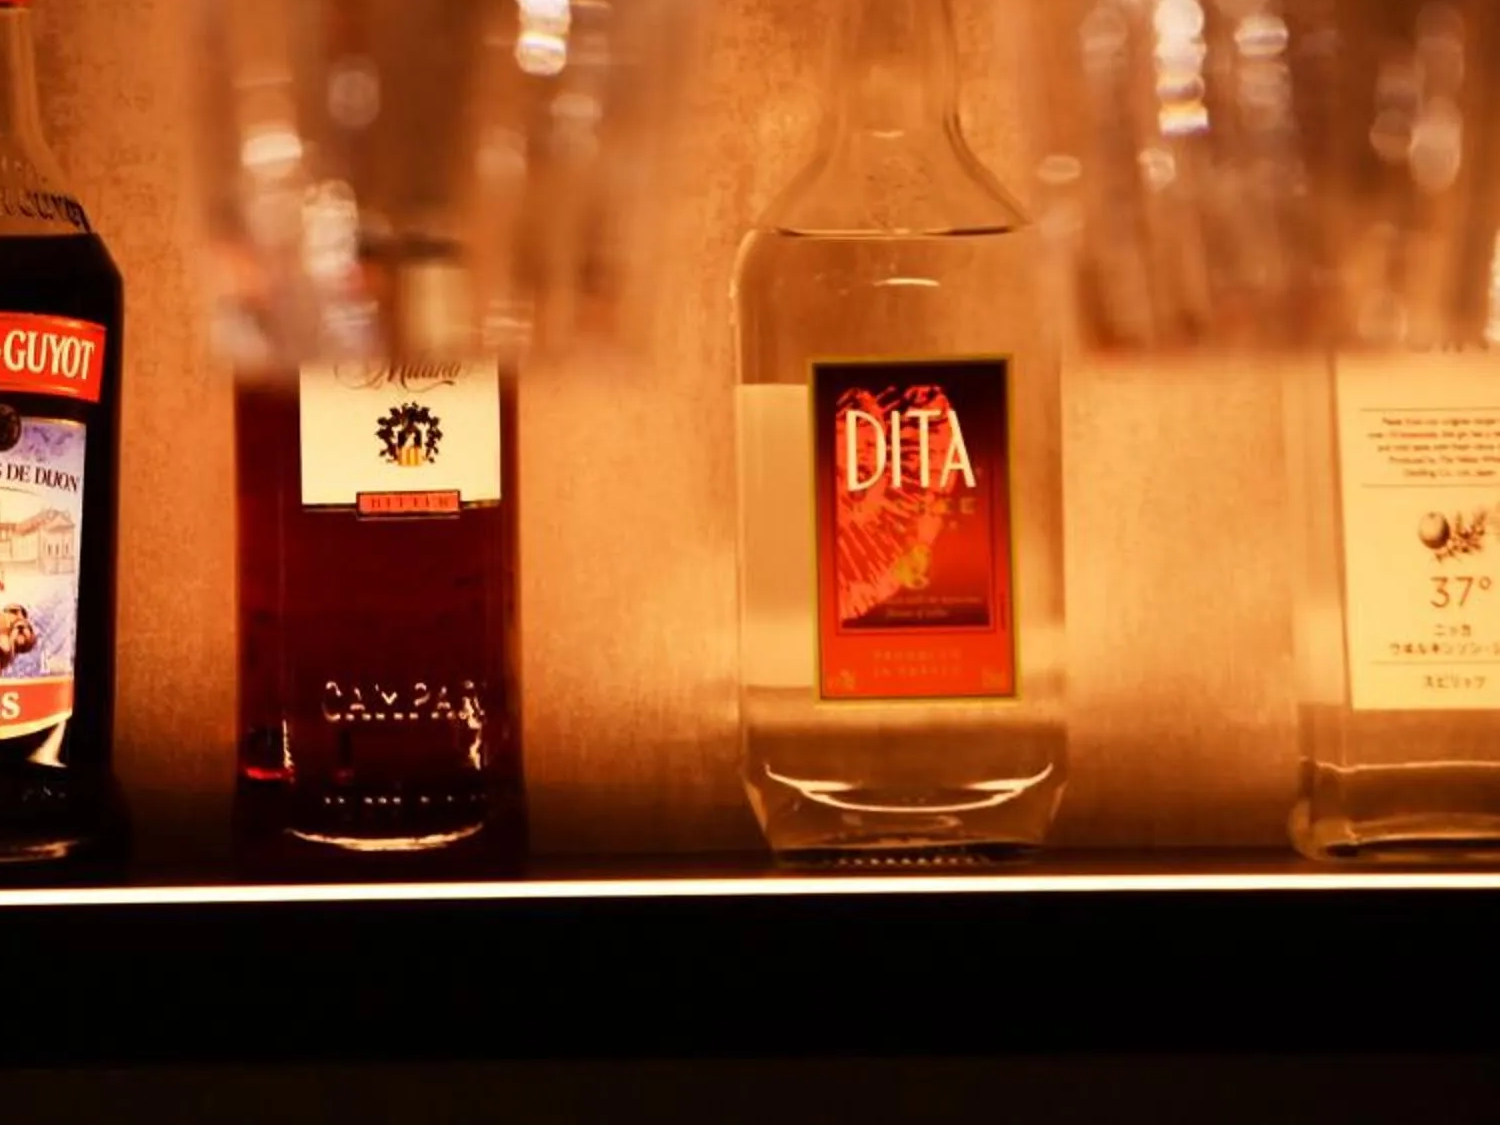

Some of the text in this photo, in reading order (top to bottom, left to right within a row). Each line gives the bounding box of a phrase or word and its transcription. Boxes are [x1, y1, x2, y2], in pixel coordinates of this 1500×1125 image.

[6, 463, 31, 483] DE
[35, 466, 81, 494] DIJON
[846, 409, 977, 492] DITA
